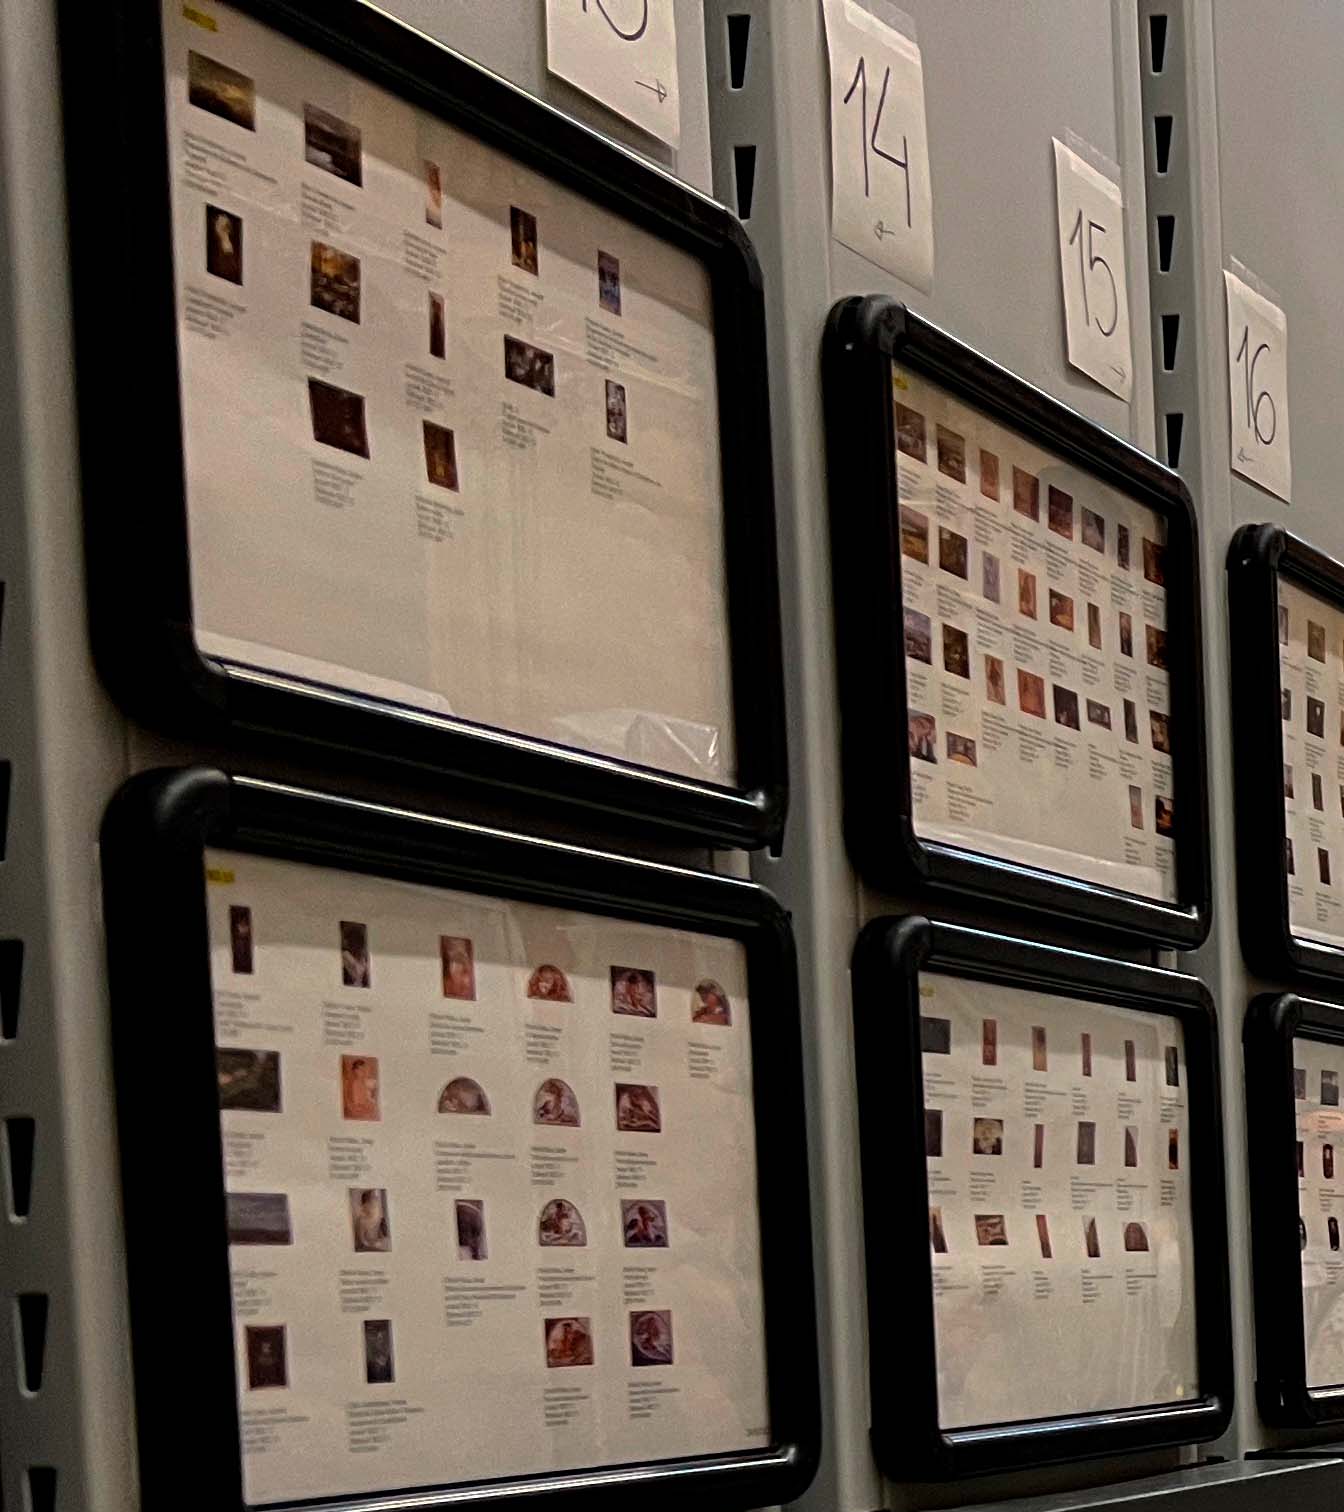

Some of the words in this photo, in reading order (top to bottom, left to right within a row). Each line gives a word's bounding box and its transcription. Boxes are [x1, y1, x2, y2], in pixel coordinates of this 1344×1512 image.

[844, 56, 912, 229] 14
[1068, 208, 1118, 337] 15
[1236, 325, 1277, 446] 16
